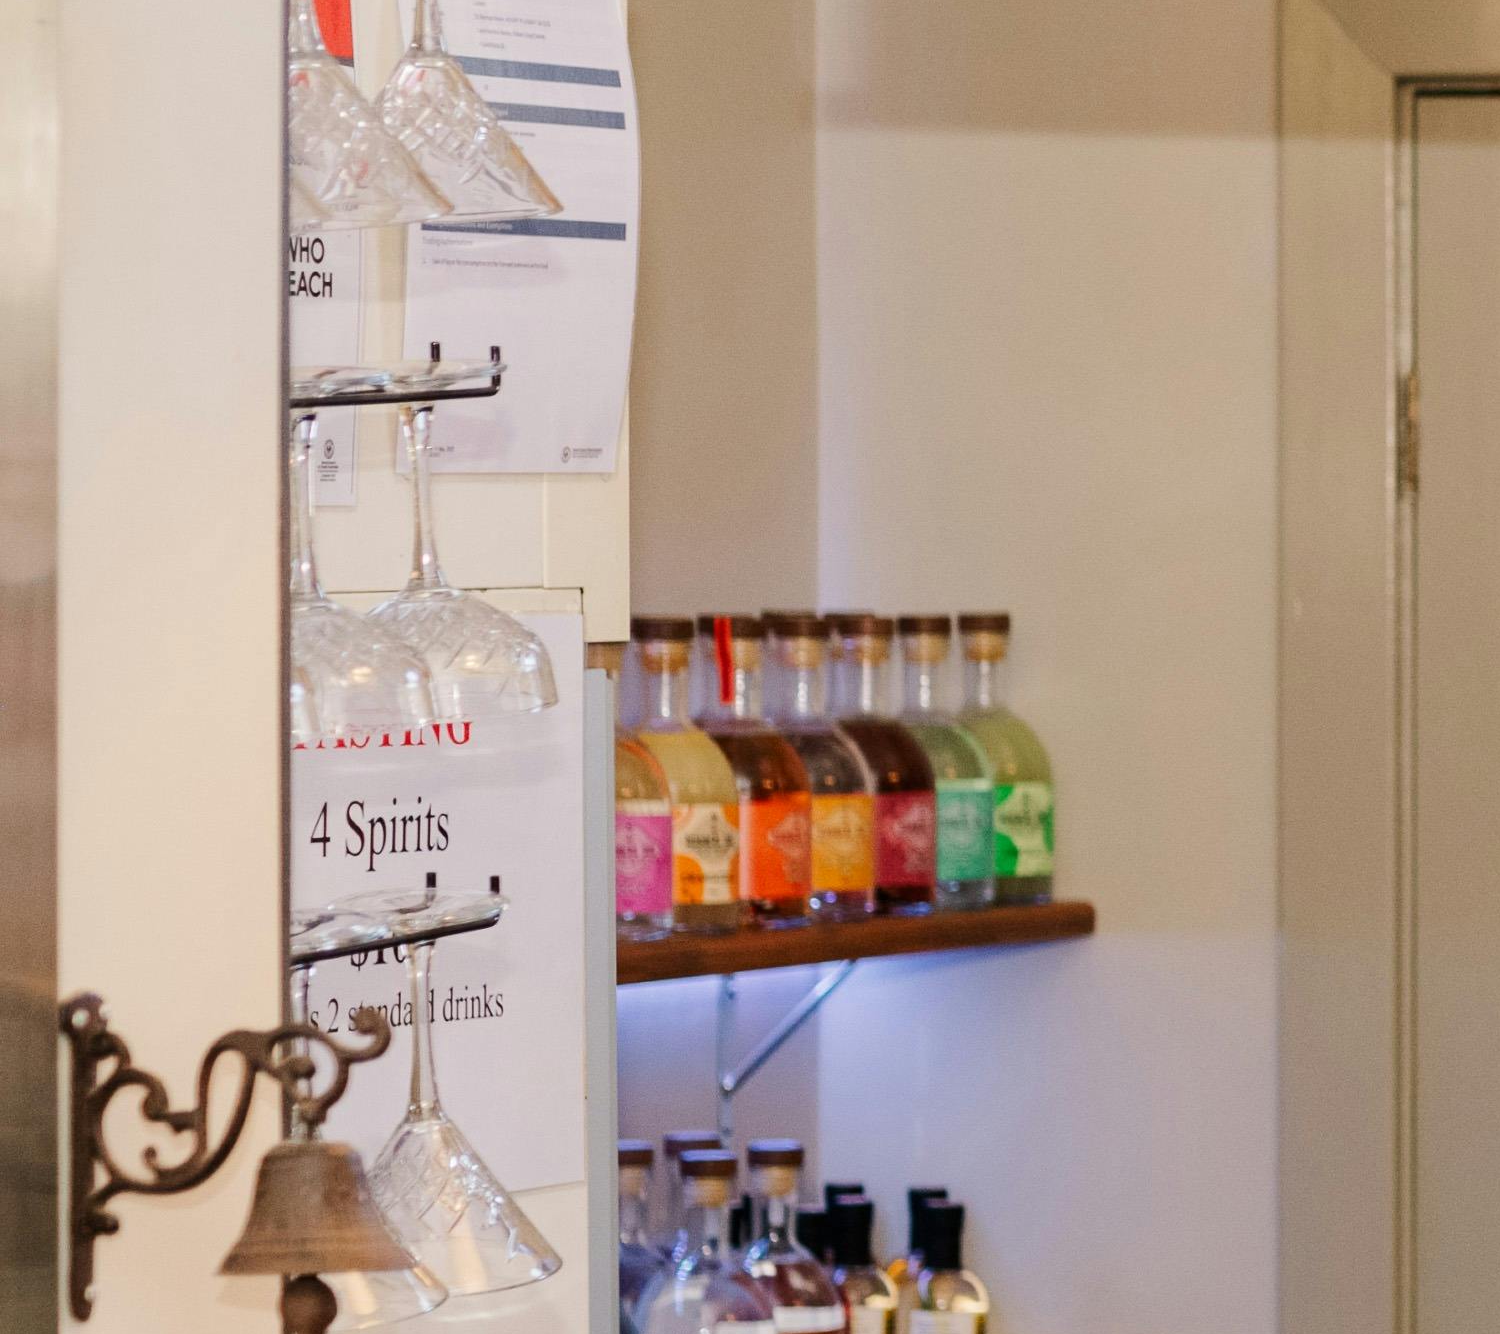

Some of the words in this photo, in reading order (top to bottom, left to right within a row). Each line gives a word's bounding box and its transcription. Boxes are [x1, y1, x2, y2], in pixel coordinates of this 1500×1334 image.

[310, 801, 331, 857] 4
[345, 795, 449, 872] Spirits
[327, 998, 339, 1033] 2
[442, 984, 504, 1023] drinks
